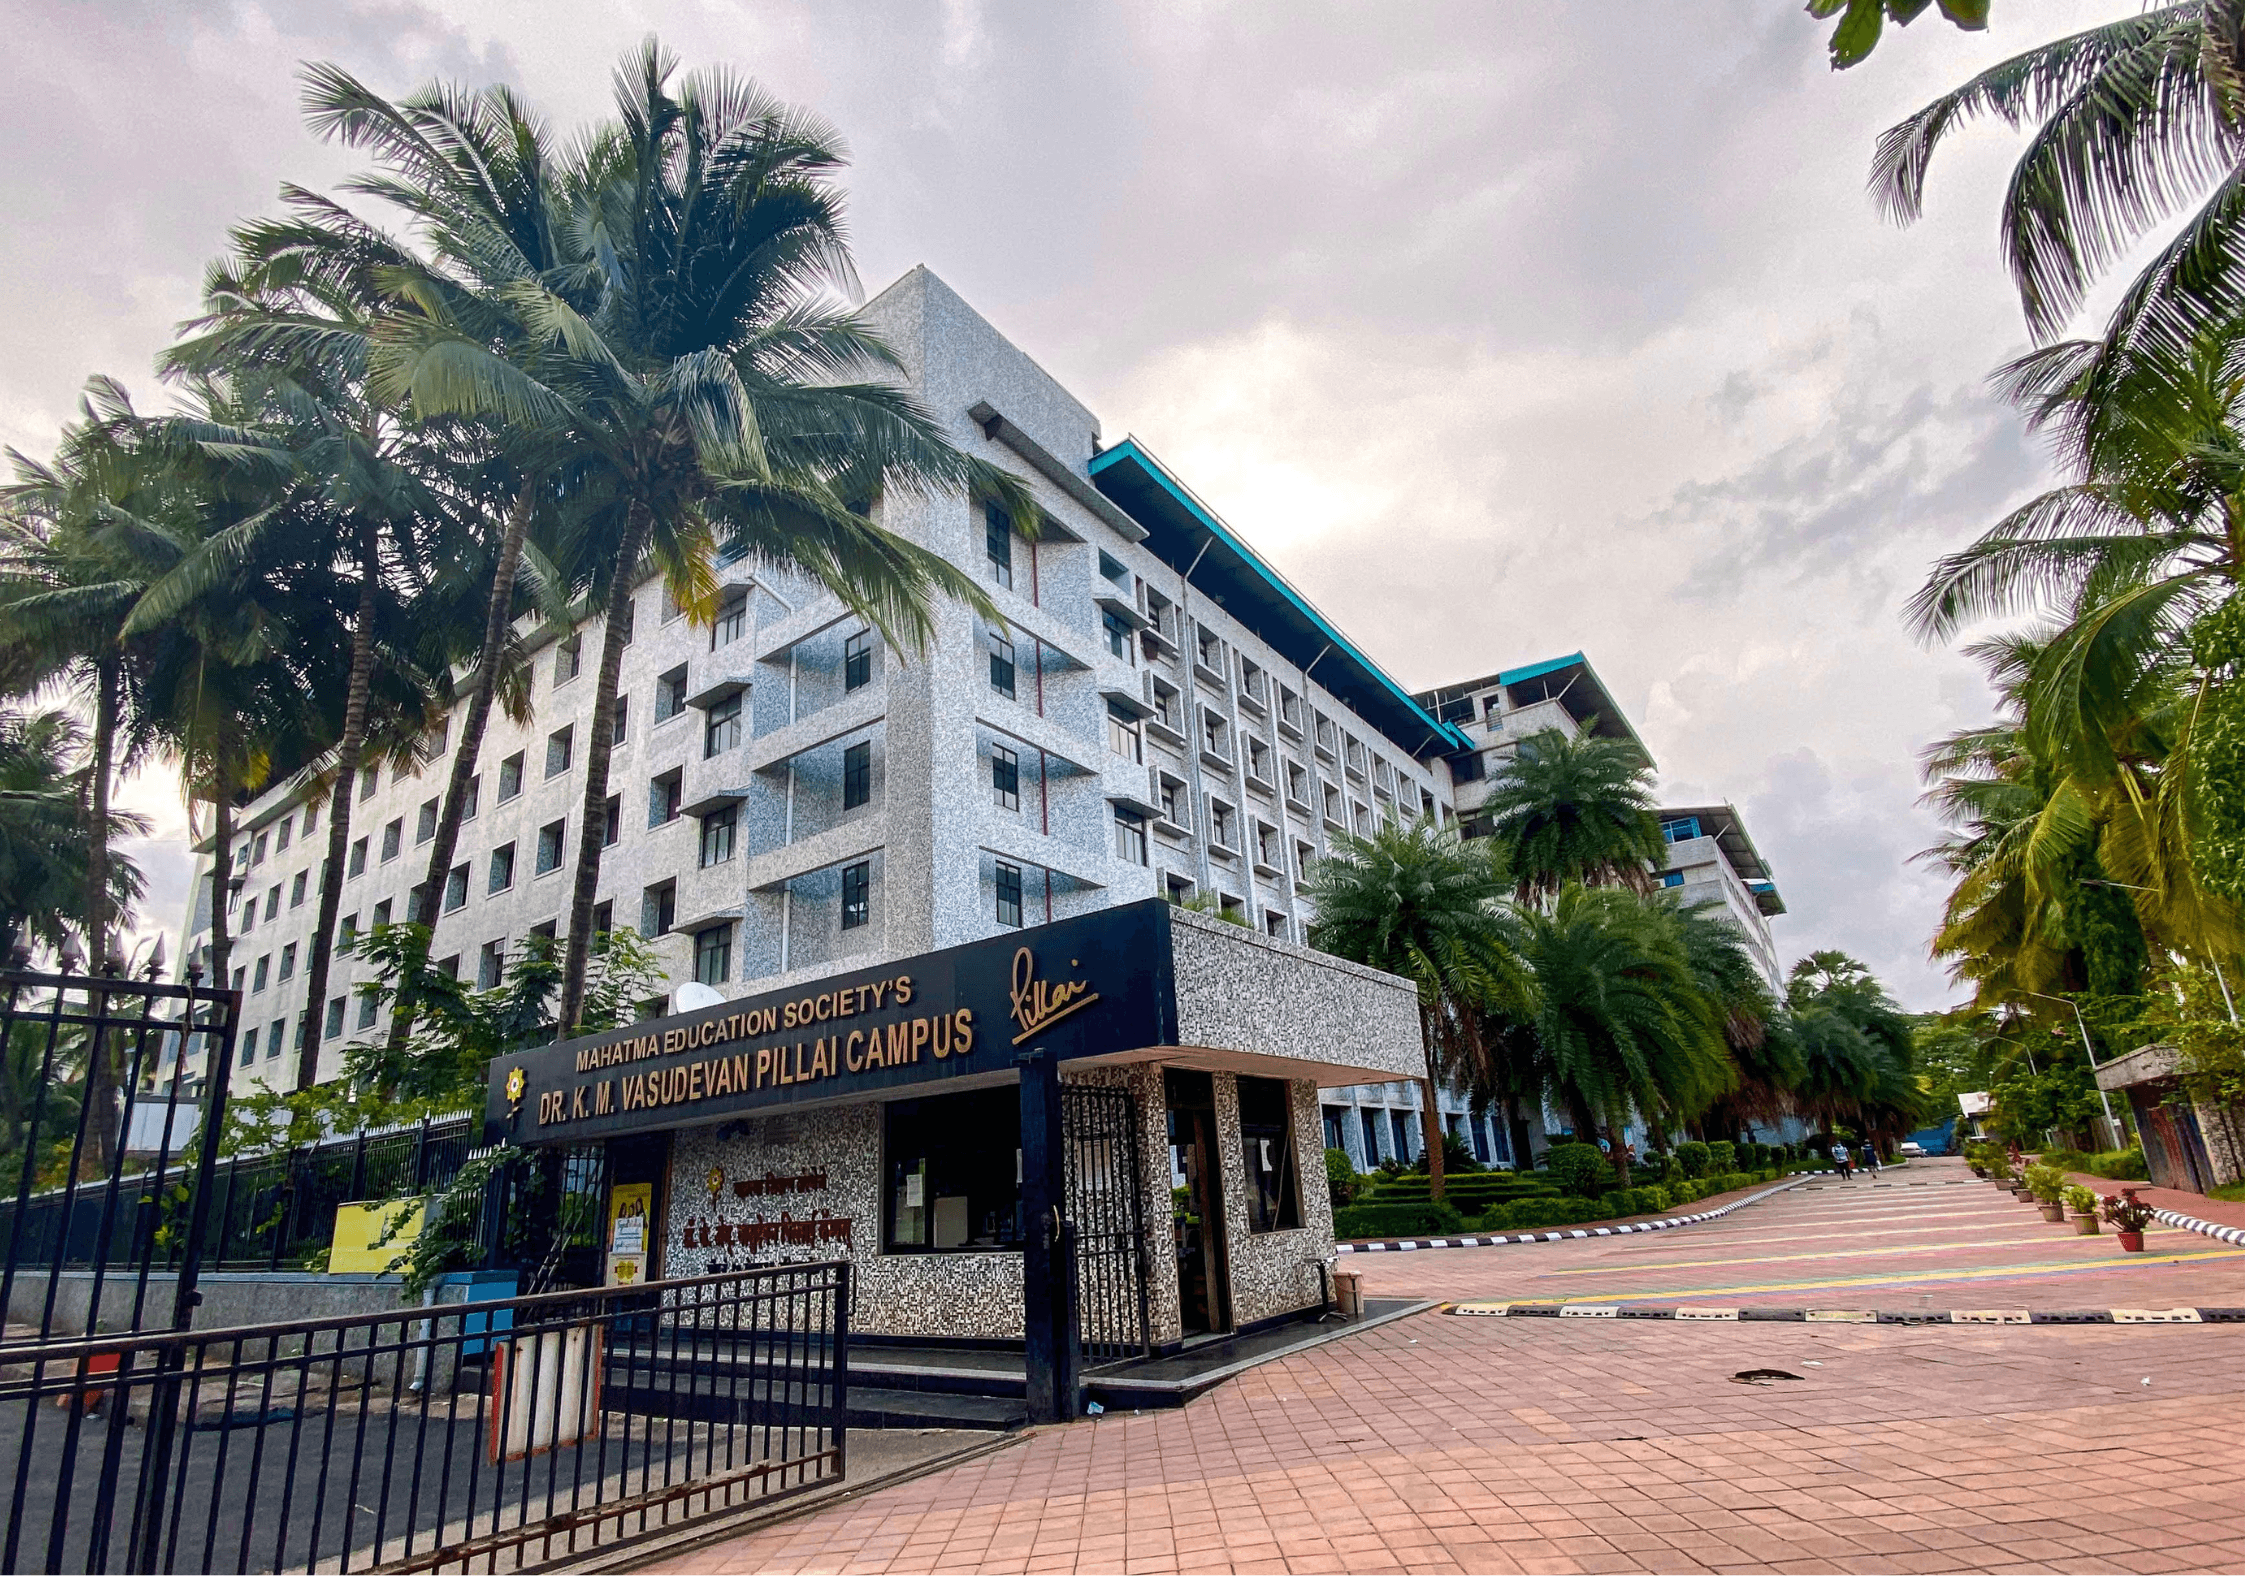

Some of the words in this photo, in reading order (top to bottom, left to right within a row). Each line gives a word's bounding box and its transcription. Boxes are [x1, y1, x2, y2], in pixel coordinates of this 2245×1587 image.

[576, 1034, 659, 1072] MAHATMA
[663, 1006, 777, 1055] EDUCATION
[783, 975, 912, 1029] SOCIETY'S
[1010, 946, 1087, 1032] Pillai
[537, 1089, 566, 1126] DR.
[572, 1085, 589, 1120] K.
[595, 1080, 615, 1116] M.
[621, 1053, 749, 1111] VASUDEVAN
[756, 1035, 838, 1089] PILLAI
[846, 1007, 974, 1073] CAMPUS
